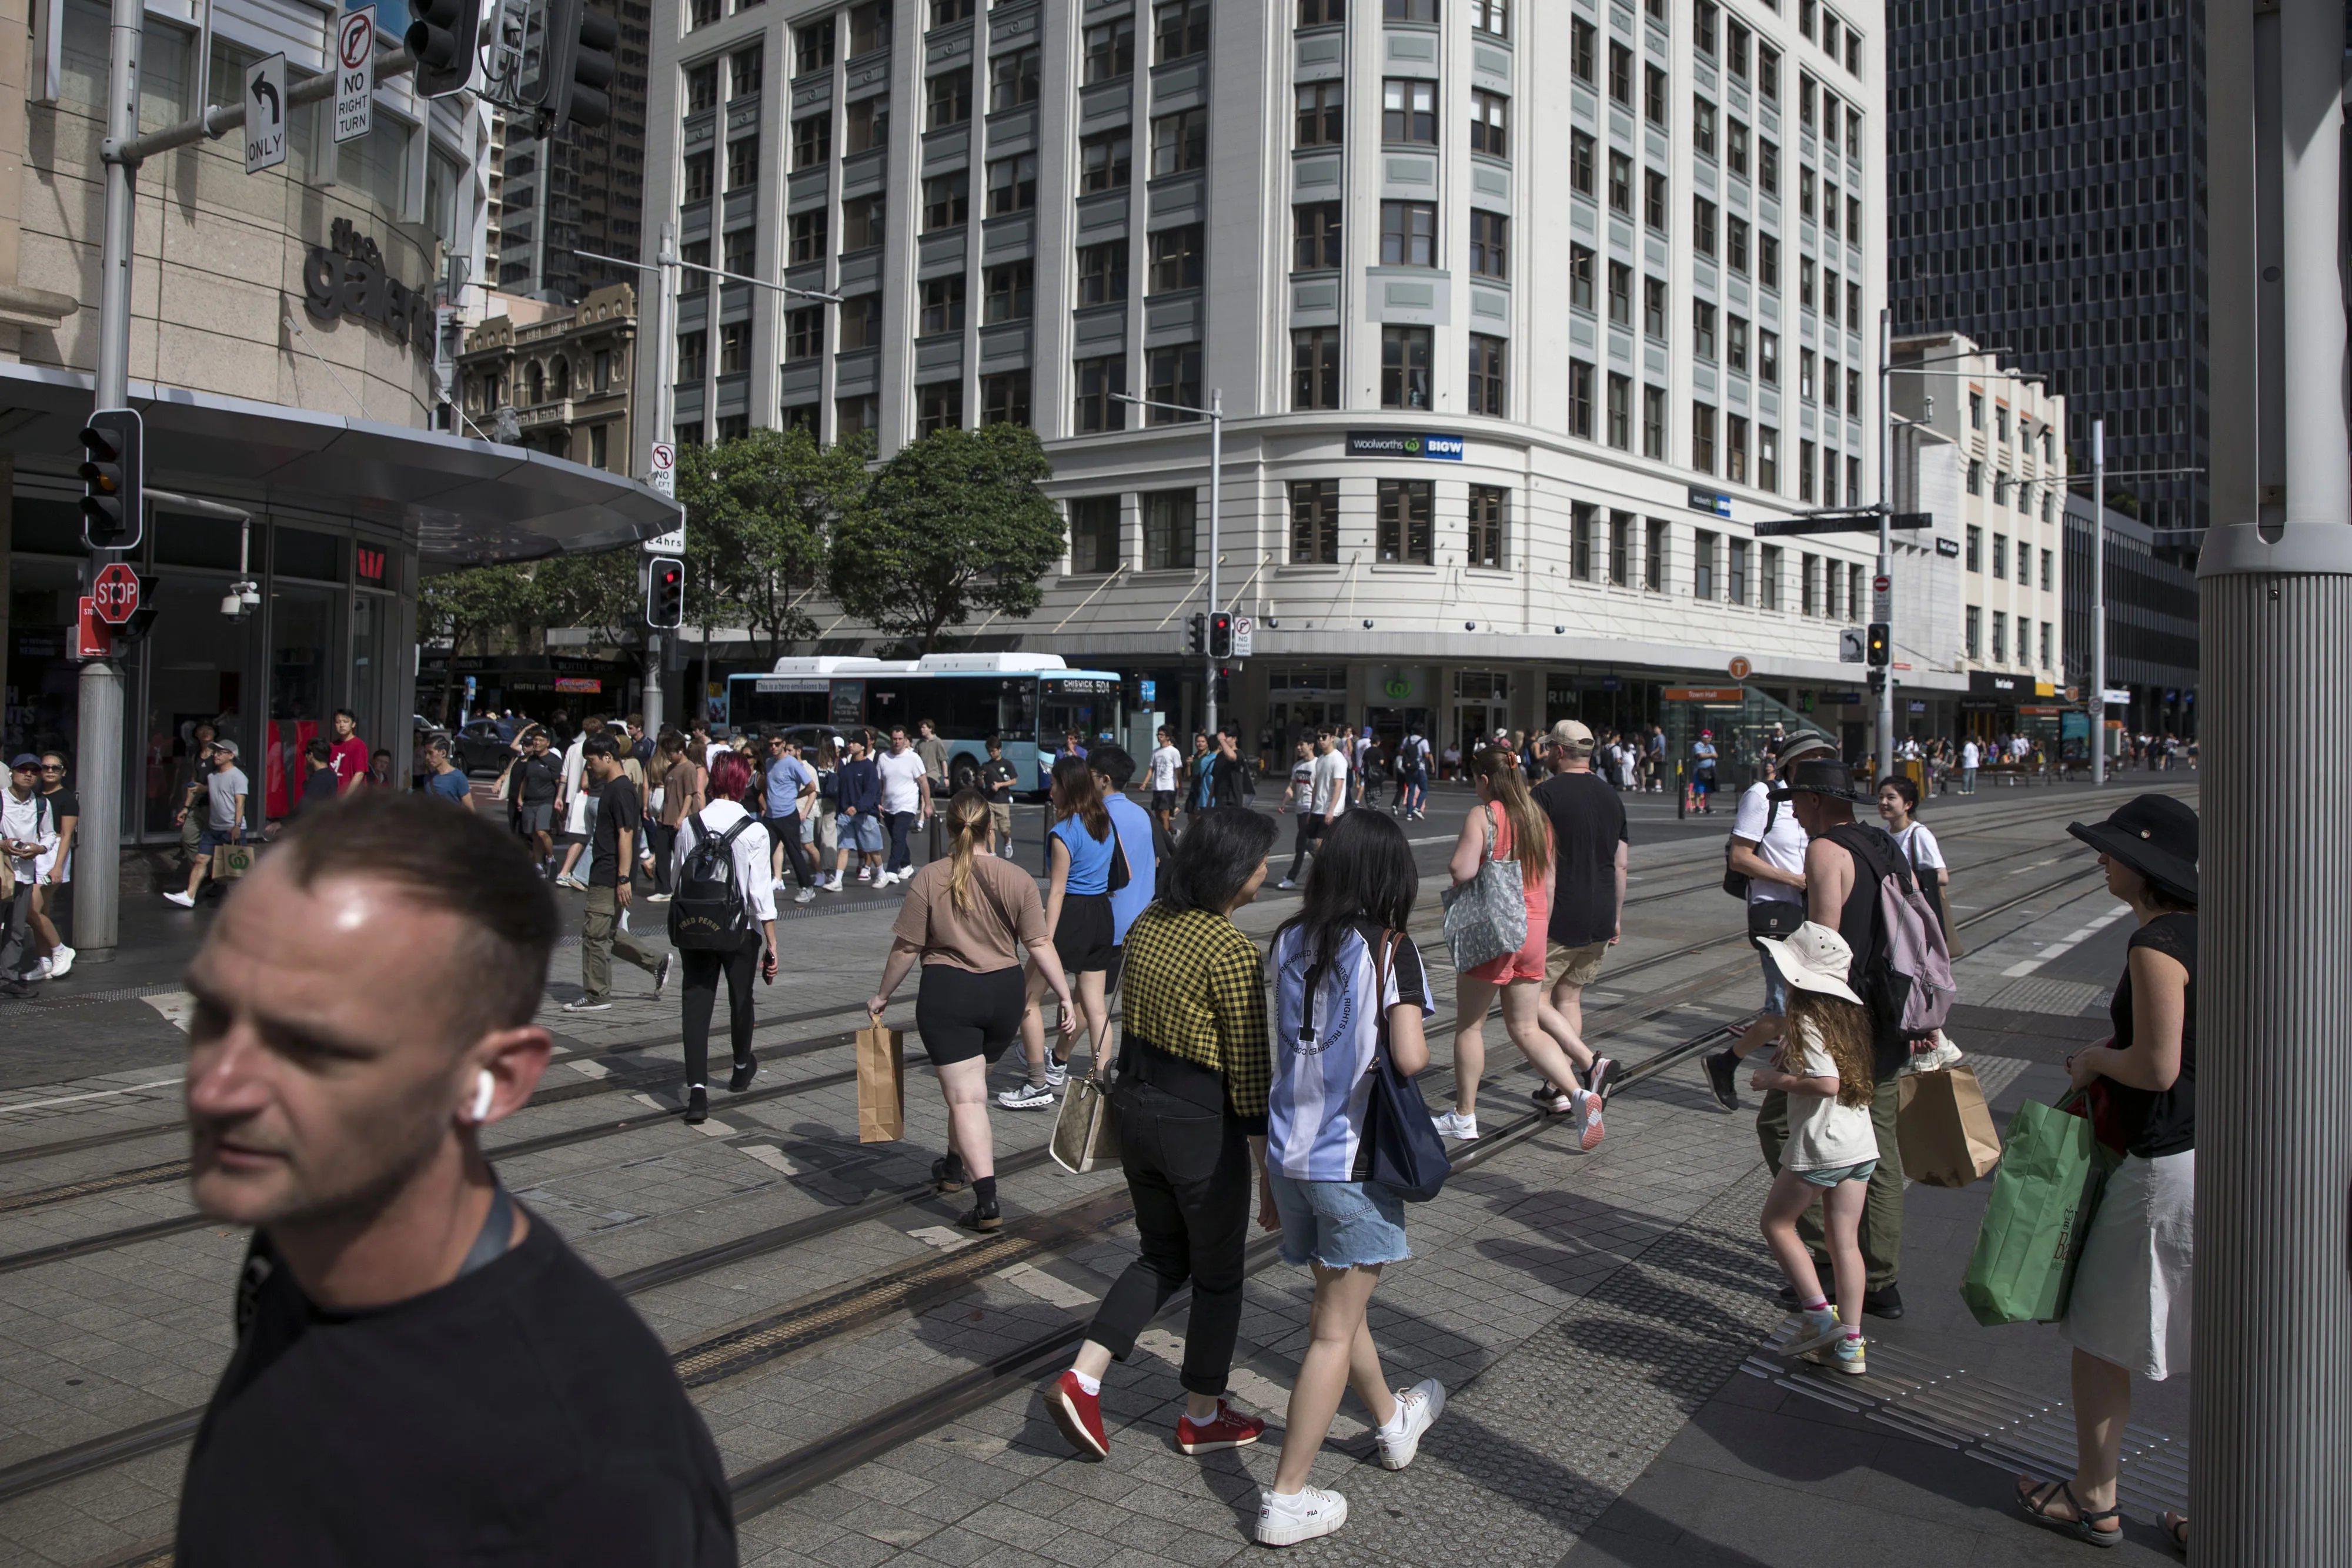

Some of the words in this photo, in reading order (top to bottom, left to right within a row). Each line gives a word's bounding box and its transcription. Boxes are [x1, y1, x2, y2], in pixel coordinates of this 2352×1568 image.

[344, 73, 364, 96] NO
[339, 95, 368, 116] RIGHT
[339, 114, 366, 133] TURN
[249, 133, 282, 161] ONLY
[331, 217, 378, 265] the
[656, 470, 669, 480] NO
[98, 583, 136, 604] STOP
[757, 683, 768, 691] This
[1063, 679, 1093, 687] CHISWICK
[1095, 680, 1110, 694] 504
[679, 917, 696, 930] FRED
[698, 917, 720, 931] PERRY
[1280, 950, 1312, 974] RESERVED
[1339, 998, 1351, 1030] RIGHTS
[1309, 1029, 1342, 1056] RESERVED
[1307, 1509, 1318, 1517] FILA
